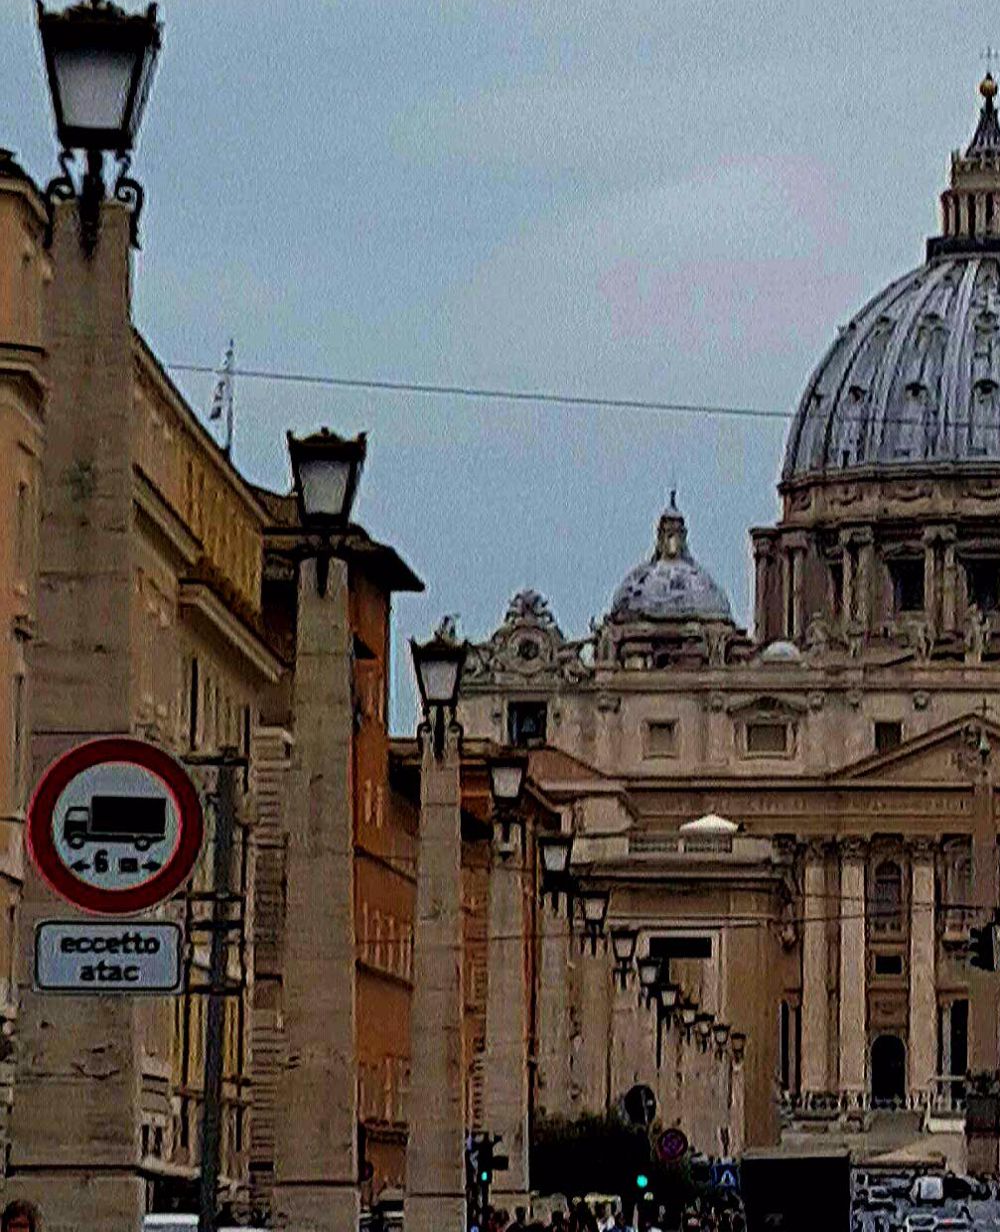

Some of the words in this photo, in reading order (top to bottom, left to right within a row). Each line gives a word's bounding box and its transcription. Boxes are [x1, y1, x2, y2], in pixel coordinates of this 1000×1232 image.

[94, 849, 109, 873] 6
[60, 931, 160, 954] eccetto
[80, 959, 141, 981] atac
